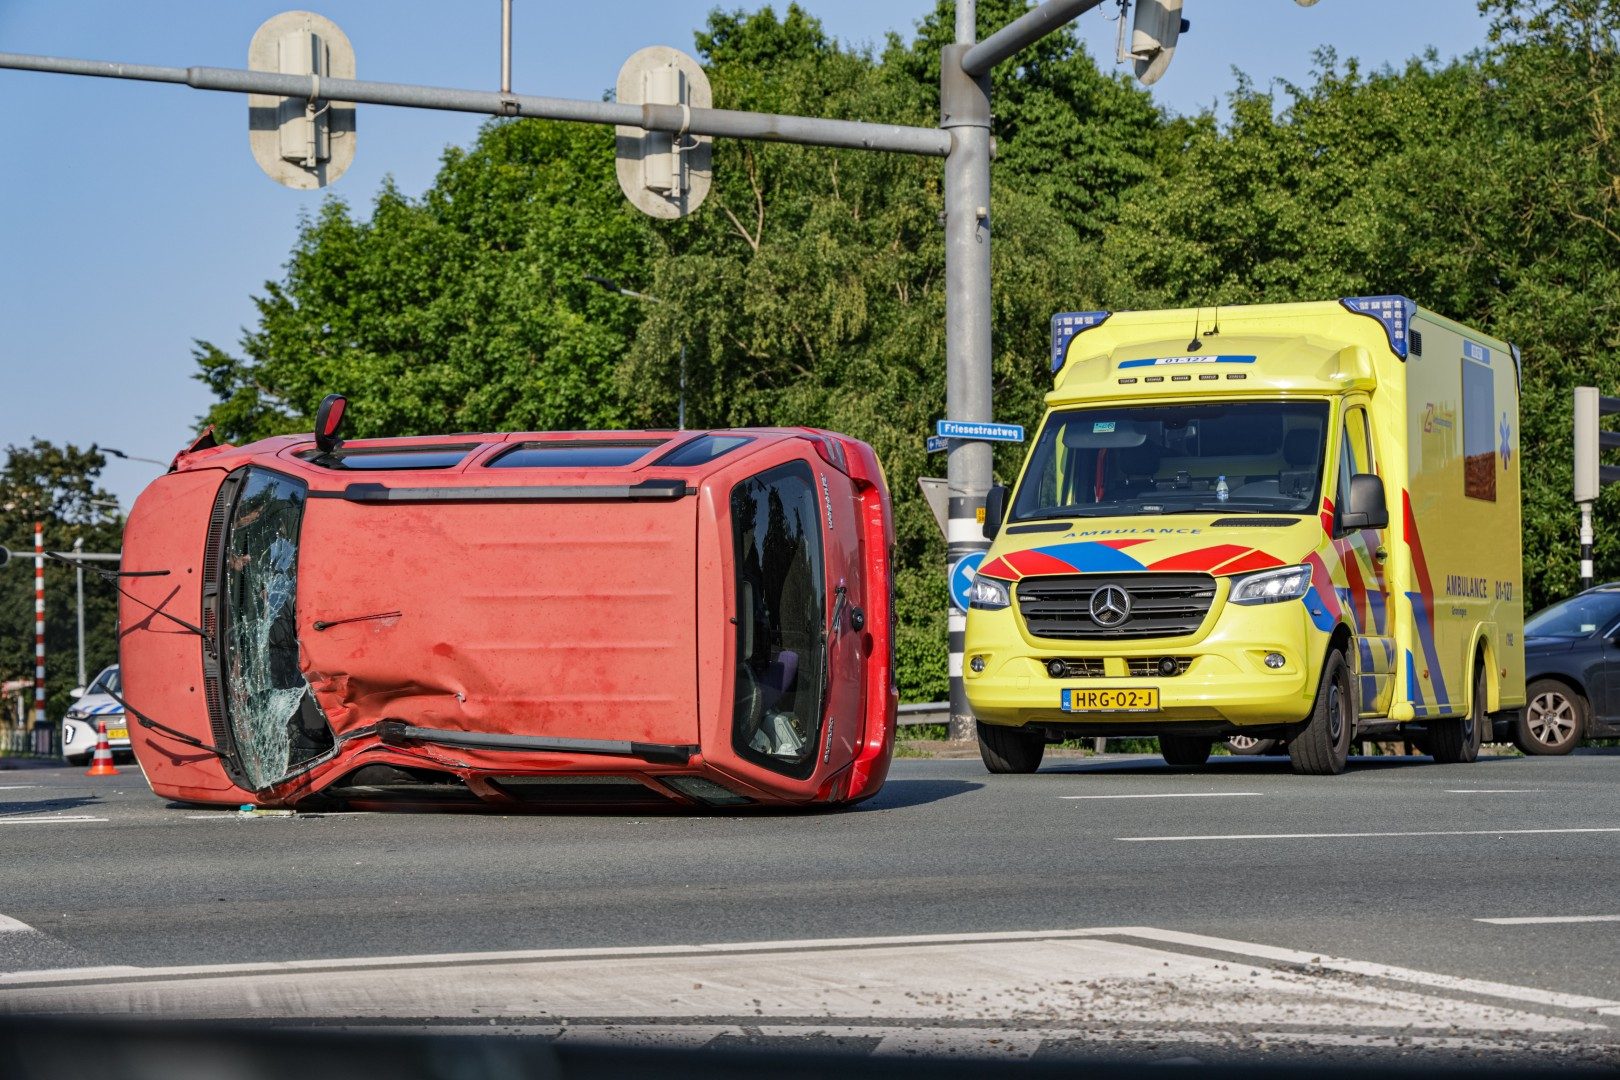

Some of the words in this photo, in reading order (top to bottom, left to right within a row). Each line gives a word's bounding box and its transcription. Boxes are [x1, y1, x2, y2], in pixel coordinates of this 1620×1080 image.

[944, 424, 1018, 439] Friesestraatweg
[1062, 528, 1203, 539] AMBULANCE
[1446, 574, 1487, 598] AMBULANCE
[1495, 580, 1512, 601] 01-127
[1076, 692, 1152, 707] HRG-02-J
